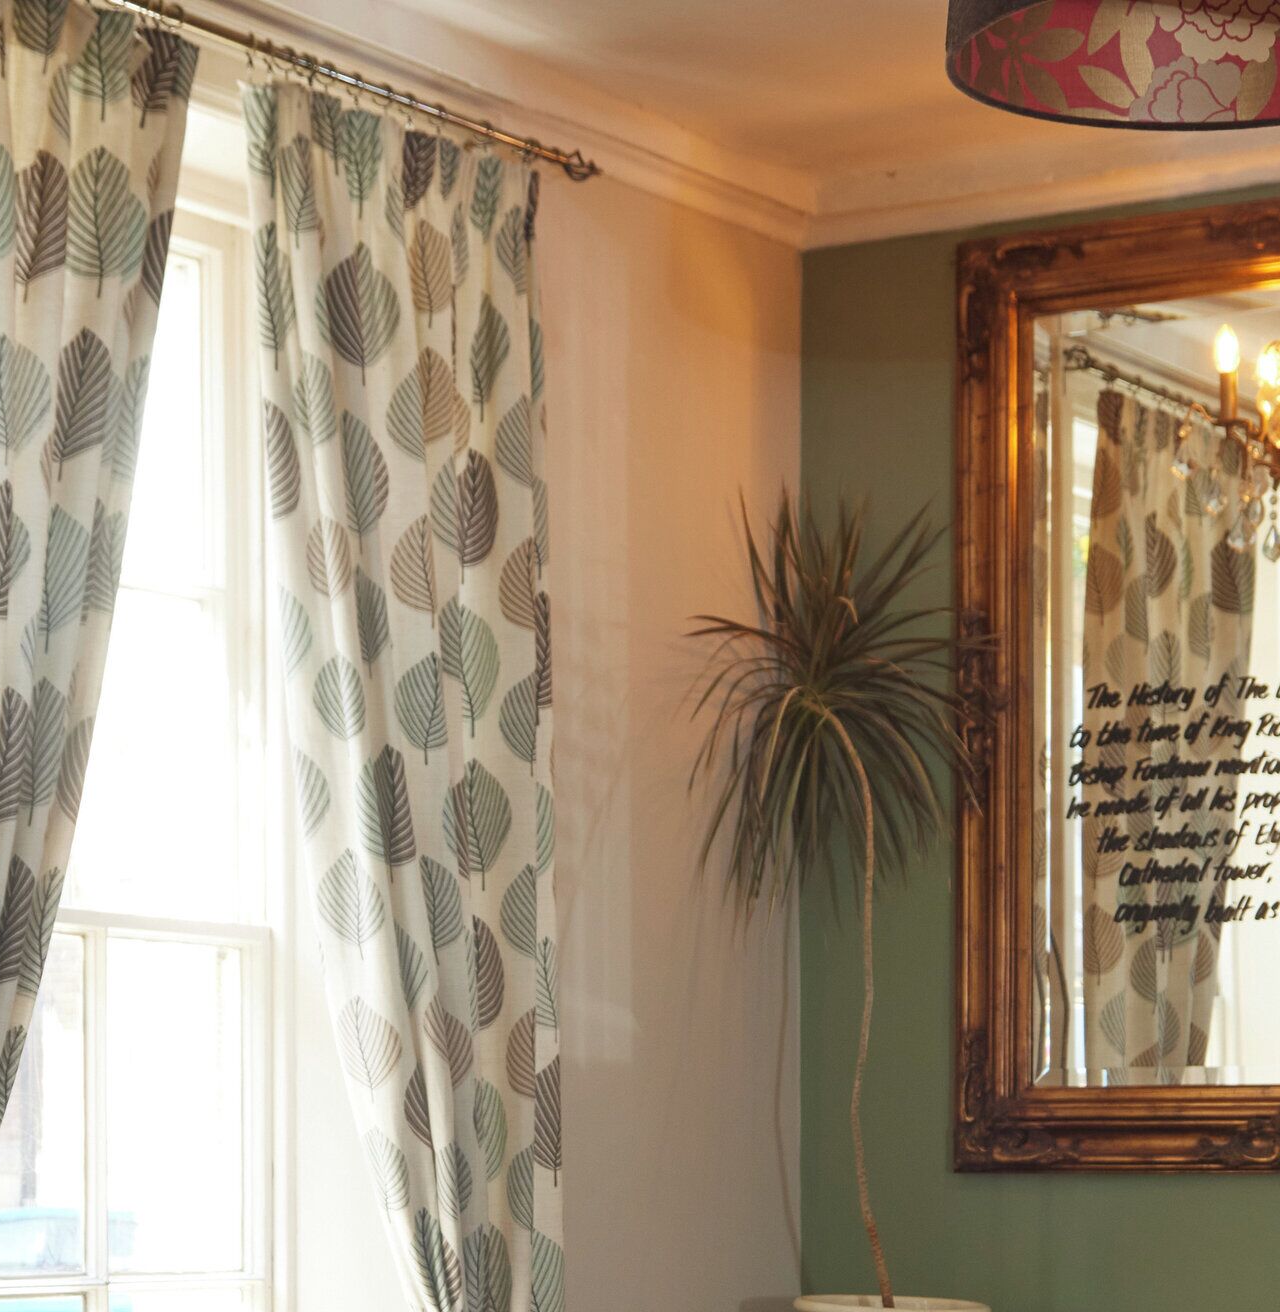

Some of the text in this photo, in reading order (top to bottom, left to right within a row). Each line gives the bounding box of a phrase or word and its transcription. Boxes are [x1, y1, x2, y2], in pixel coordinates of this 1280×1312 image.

[1087, 682, 1121, 709] The
[1127, 679, 1195, 711] History
[1204, 672, 1230, 708] of
[1236, 676, 1269, 699] The
[1070, 723, 1091, 748] to
[1137, 718, 1180, 743] time
[1185, 712, 1210, 745] of
[1209, 716, 1251, 749] King
[1066, 796, 1091, 819] he
[1154, 787, 1180, 820] of
[1179, 787, 1209, 812] all
[1209, 786, 1237, 811] his
[1097, 826, 1130, 853] the
[1134, 823, 1219, 851] shadows
[1224, 821, 1250, 856] of
[1204, 895, 1252, 923] built
[1255, 901, 1280, 920] as
